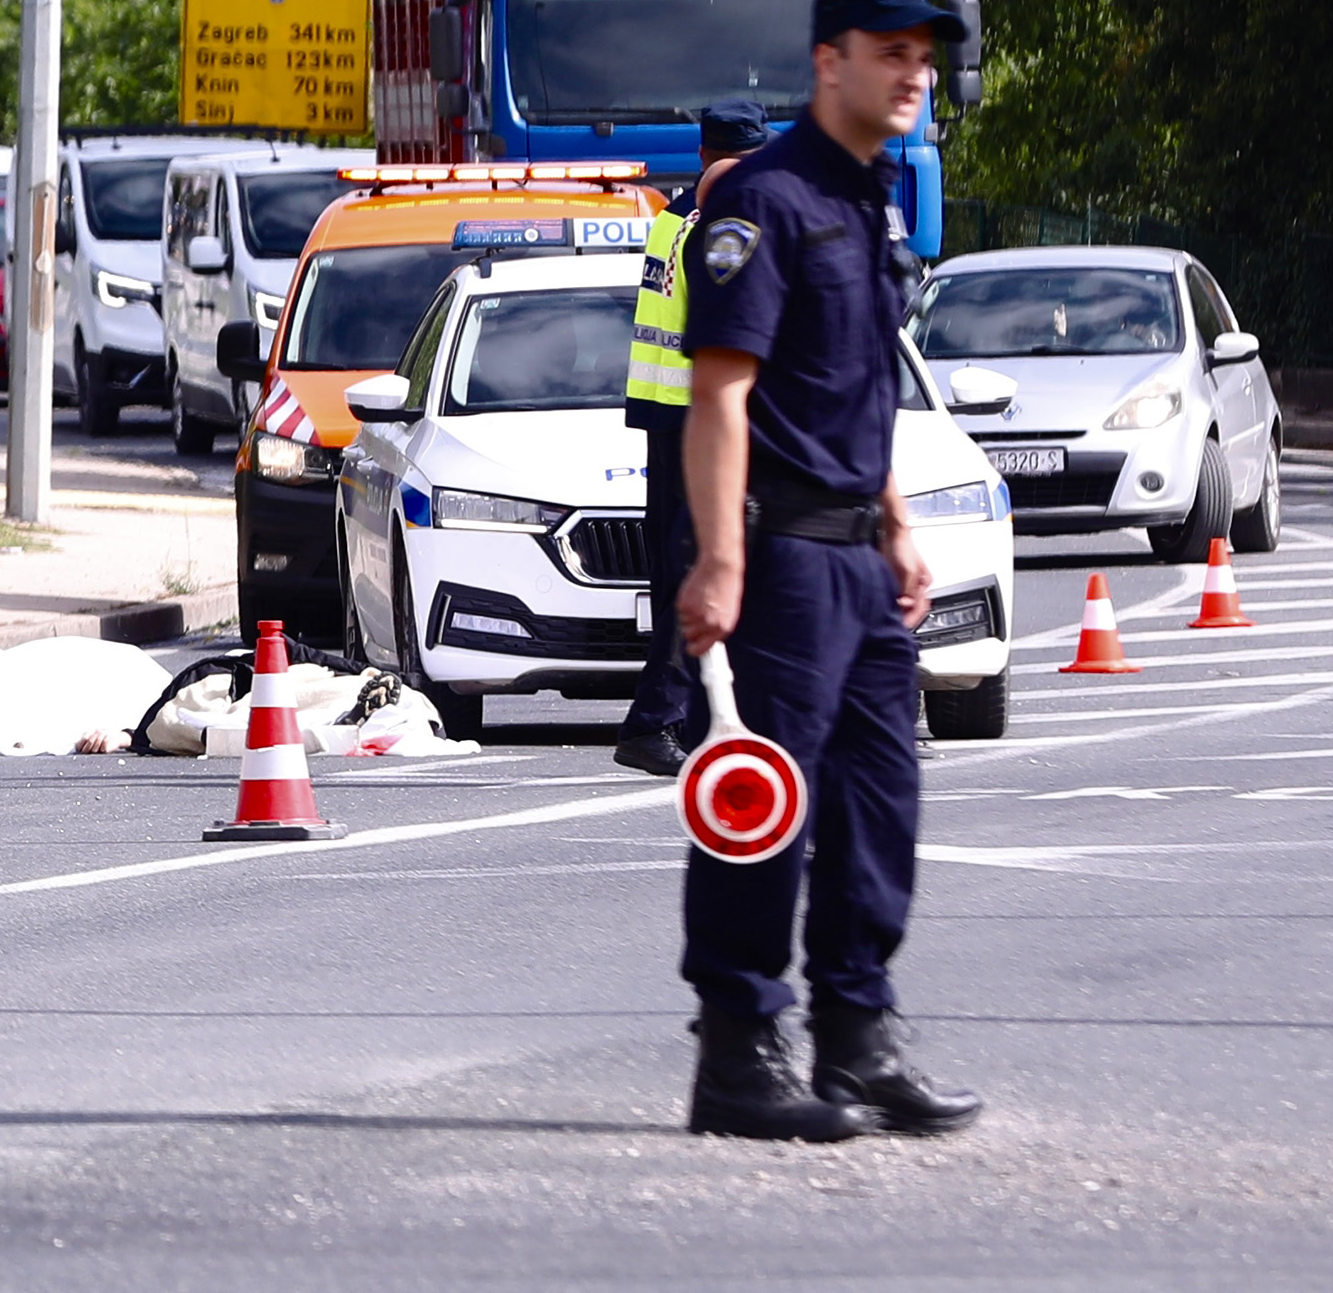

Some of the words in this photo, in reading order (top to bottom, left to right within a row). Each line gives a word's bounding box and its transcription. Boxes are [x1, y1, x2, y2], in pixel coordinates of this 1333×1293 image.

[198, 21, 268, 43] Zagreb
[290, 22, 320, 42] 341
[326, 23, 355, 42] km
[323, 52, 354, 69] km
[196, 73, 239, 94] Knin
[294, 76, 317, 95] 70
[324, 75, 353, 95] km
[196, 100, 234, 122] Sinj
[306, 103, 317, 120] 3
[323, 102, 353, 121] km
